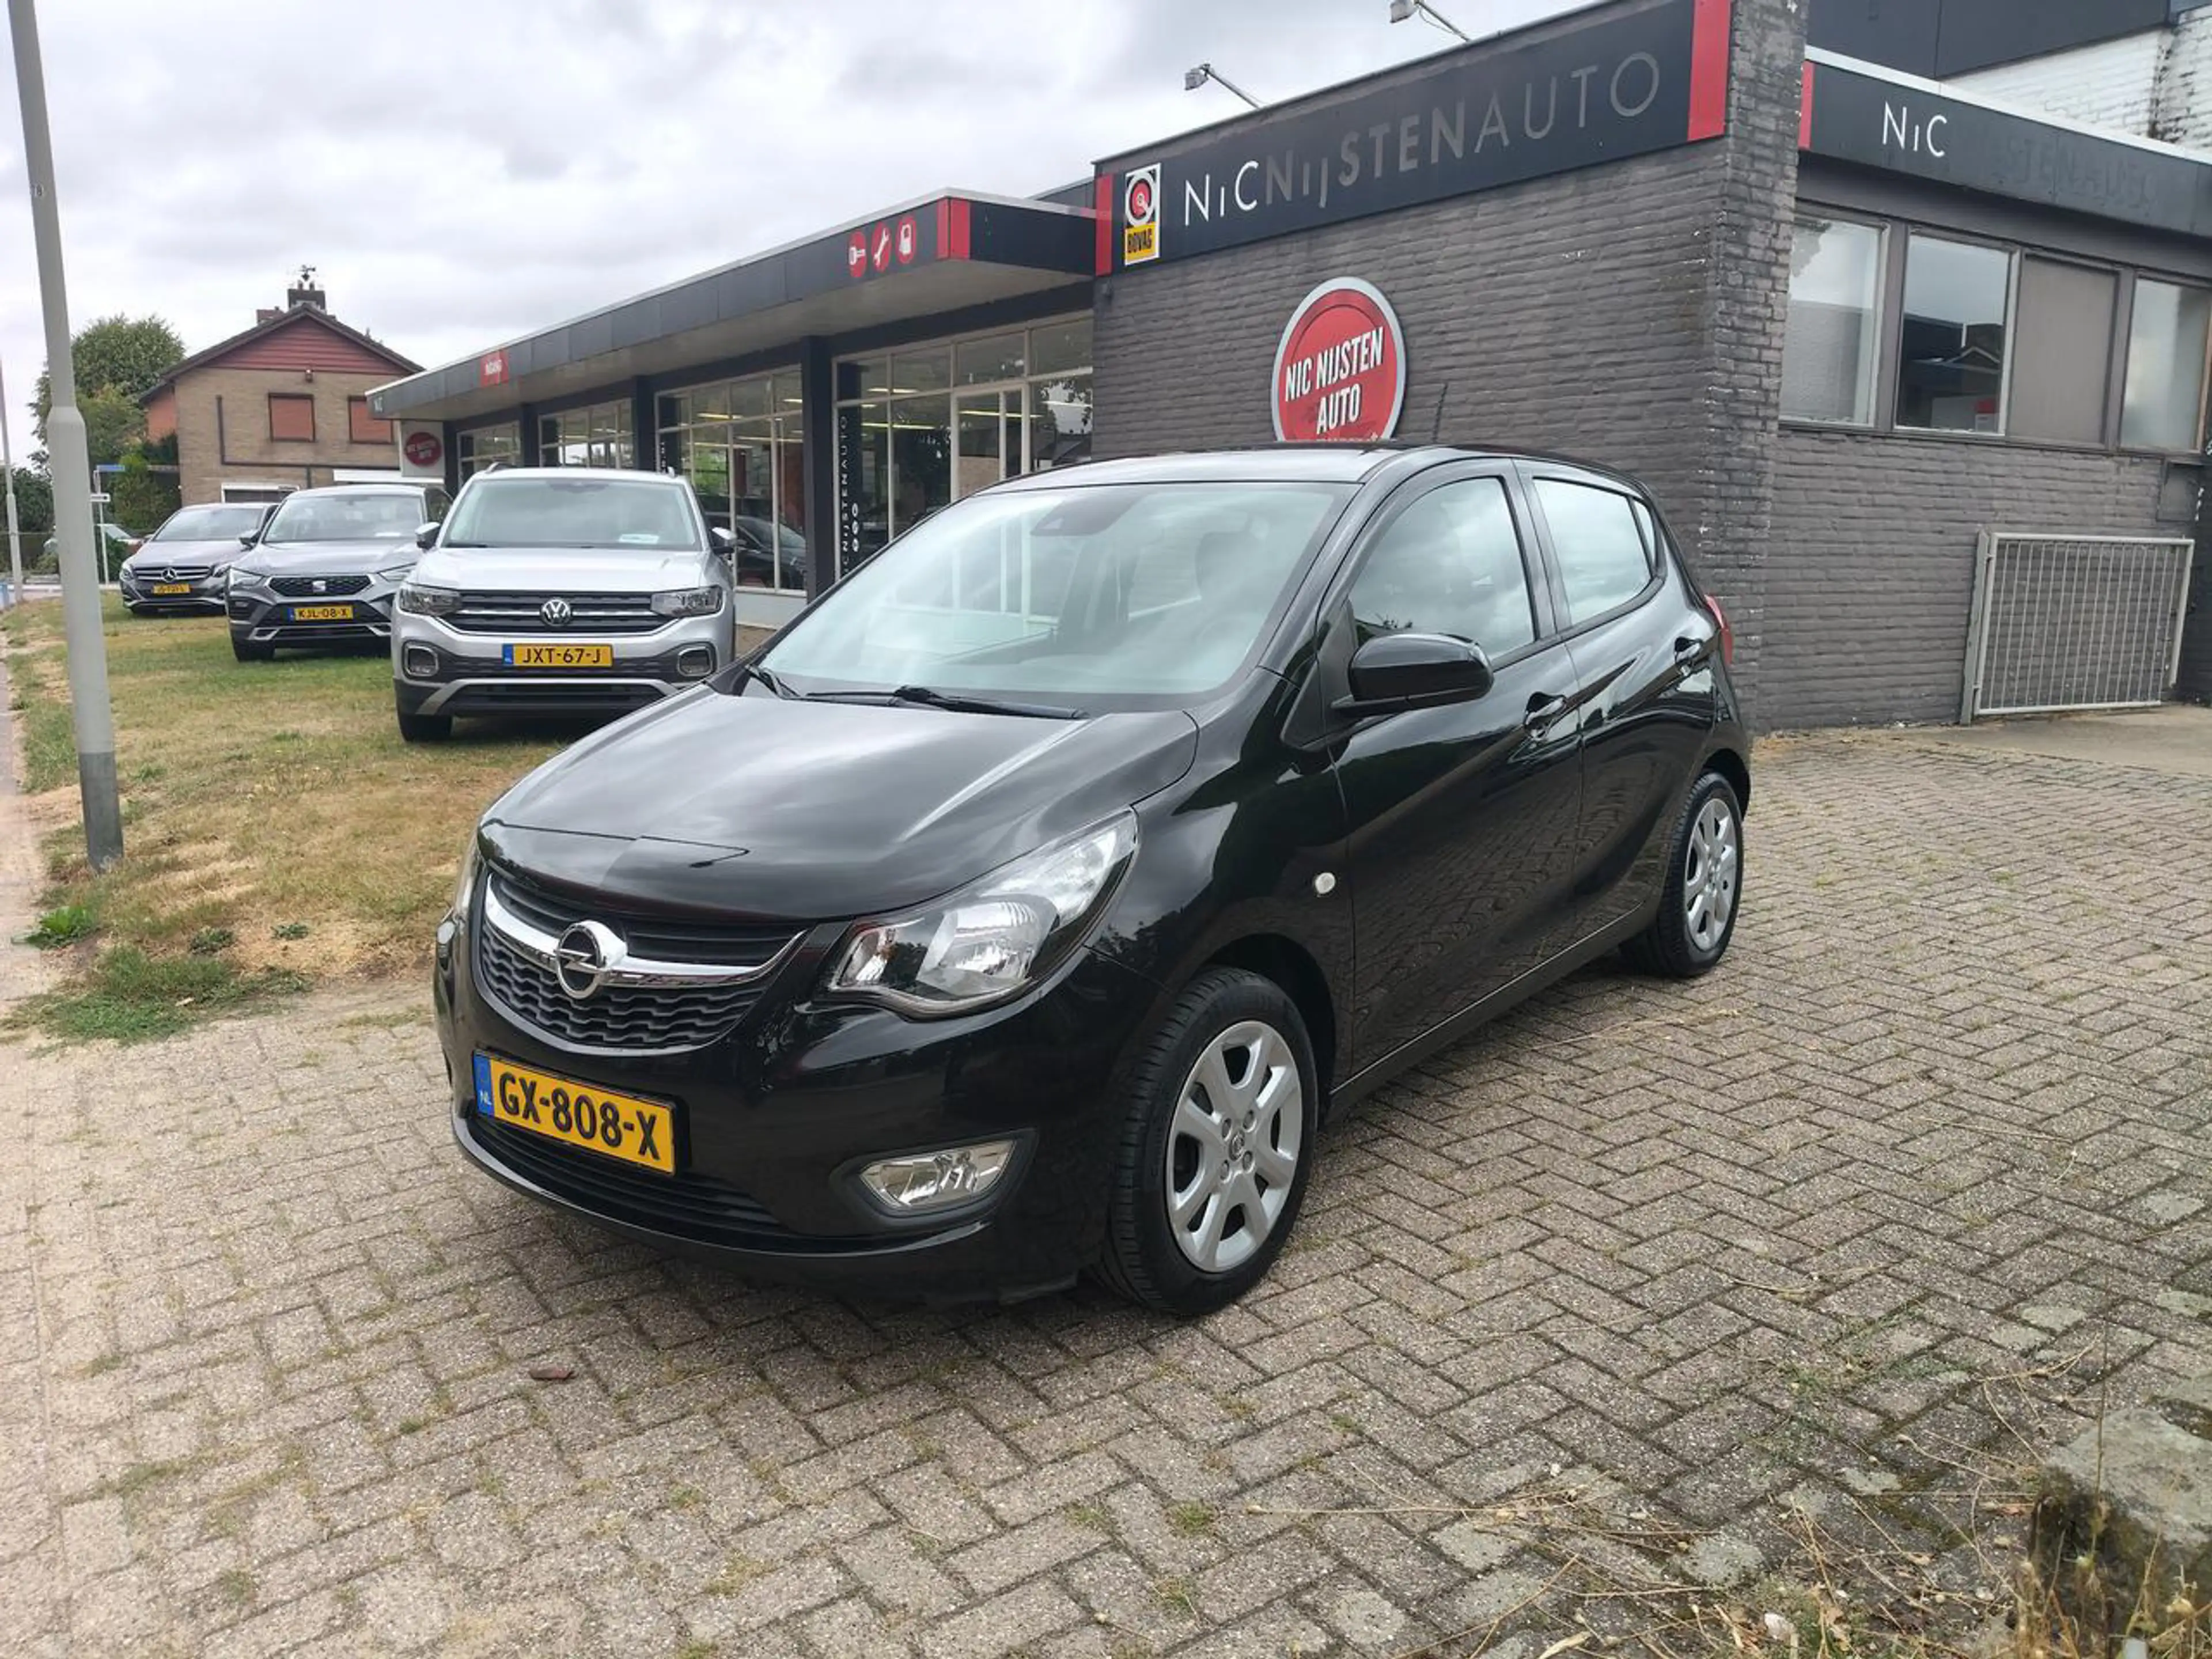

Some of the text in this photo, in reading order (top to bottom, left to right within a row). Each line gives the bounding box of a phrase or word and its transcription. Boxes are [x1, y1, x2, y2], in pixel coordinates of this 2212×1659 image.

[1285, 326, 1383, 402] NIC NIJSTEN
[1317, 383, 1361, 435] AUTO
[298, 608, 347, 618] KJL-08-X
[522, 648, 601, 664] JXT-67-J
[499, 1071, 660, 1161] GX-808-X
